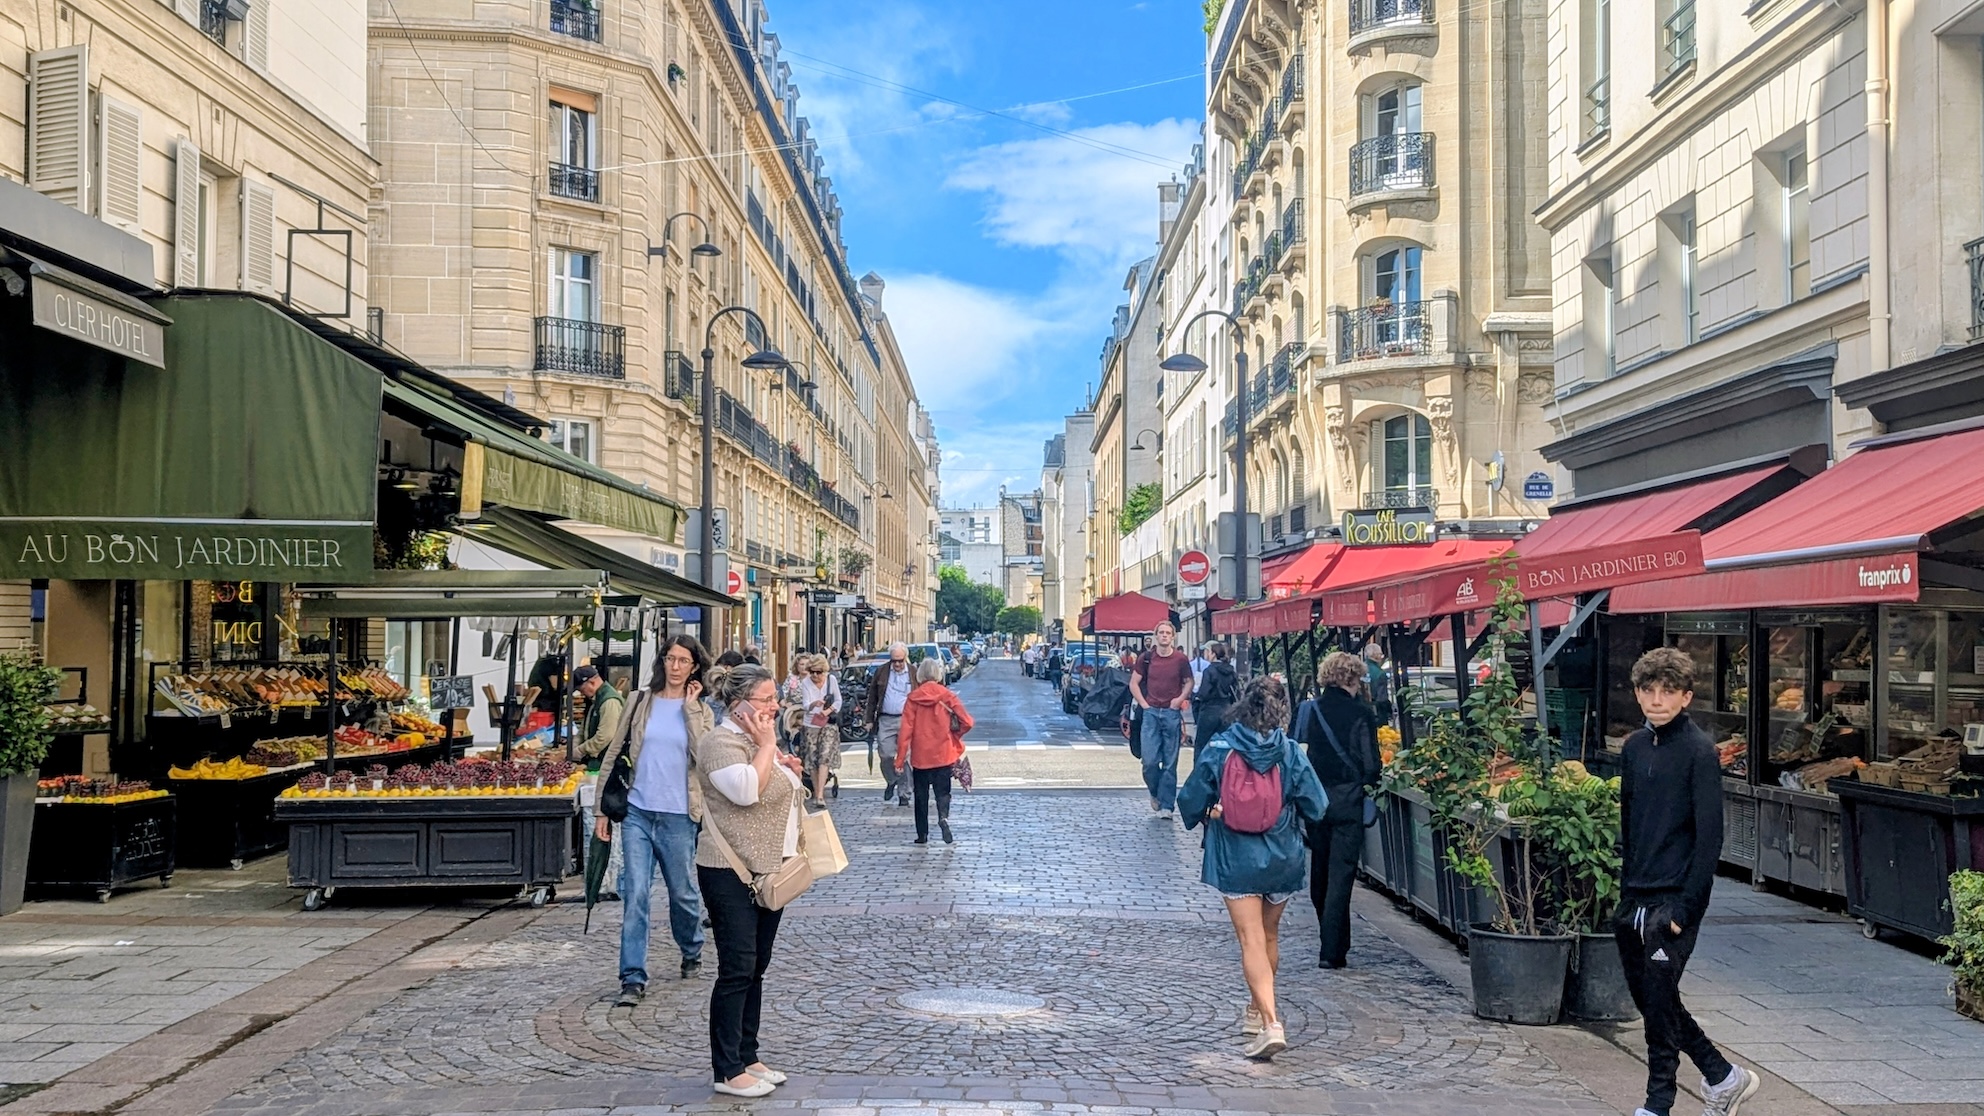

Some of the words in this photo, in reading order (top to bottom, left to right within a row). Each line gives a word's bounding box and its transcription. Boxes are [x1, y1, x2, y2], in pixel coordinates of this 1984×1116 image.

[55, 294, 97, 338] CLER
[100, 310, 150, 357] HOTEL
[18, 535, 68, 563] AU
[85, 533, 160, 564] BON
[175, 536, 343, 569] JARDINIER
[1528, 568, 1566, 589] BON
[1572, 554, 1658, 584] JARDINIER
[1664, 550, 1687, 568] BIO
[1859, 564, 1902, 591] franprix
[1456, 582, 1474, 597] AB
[431, 678, 471, 691] CERISE
